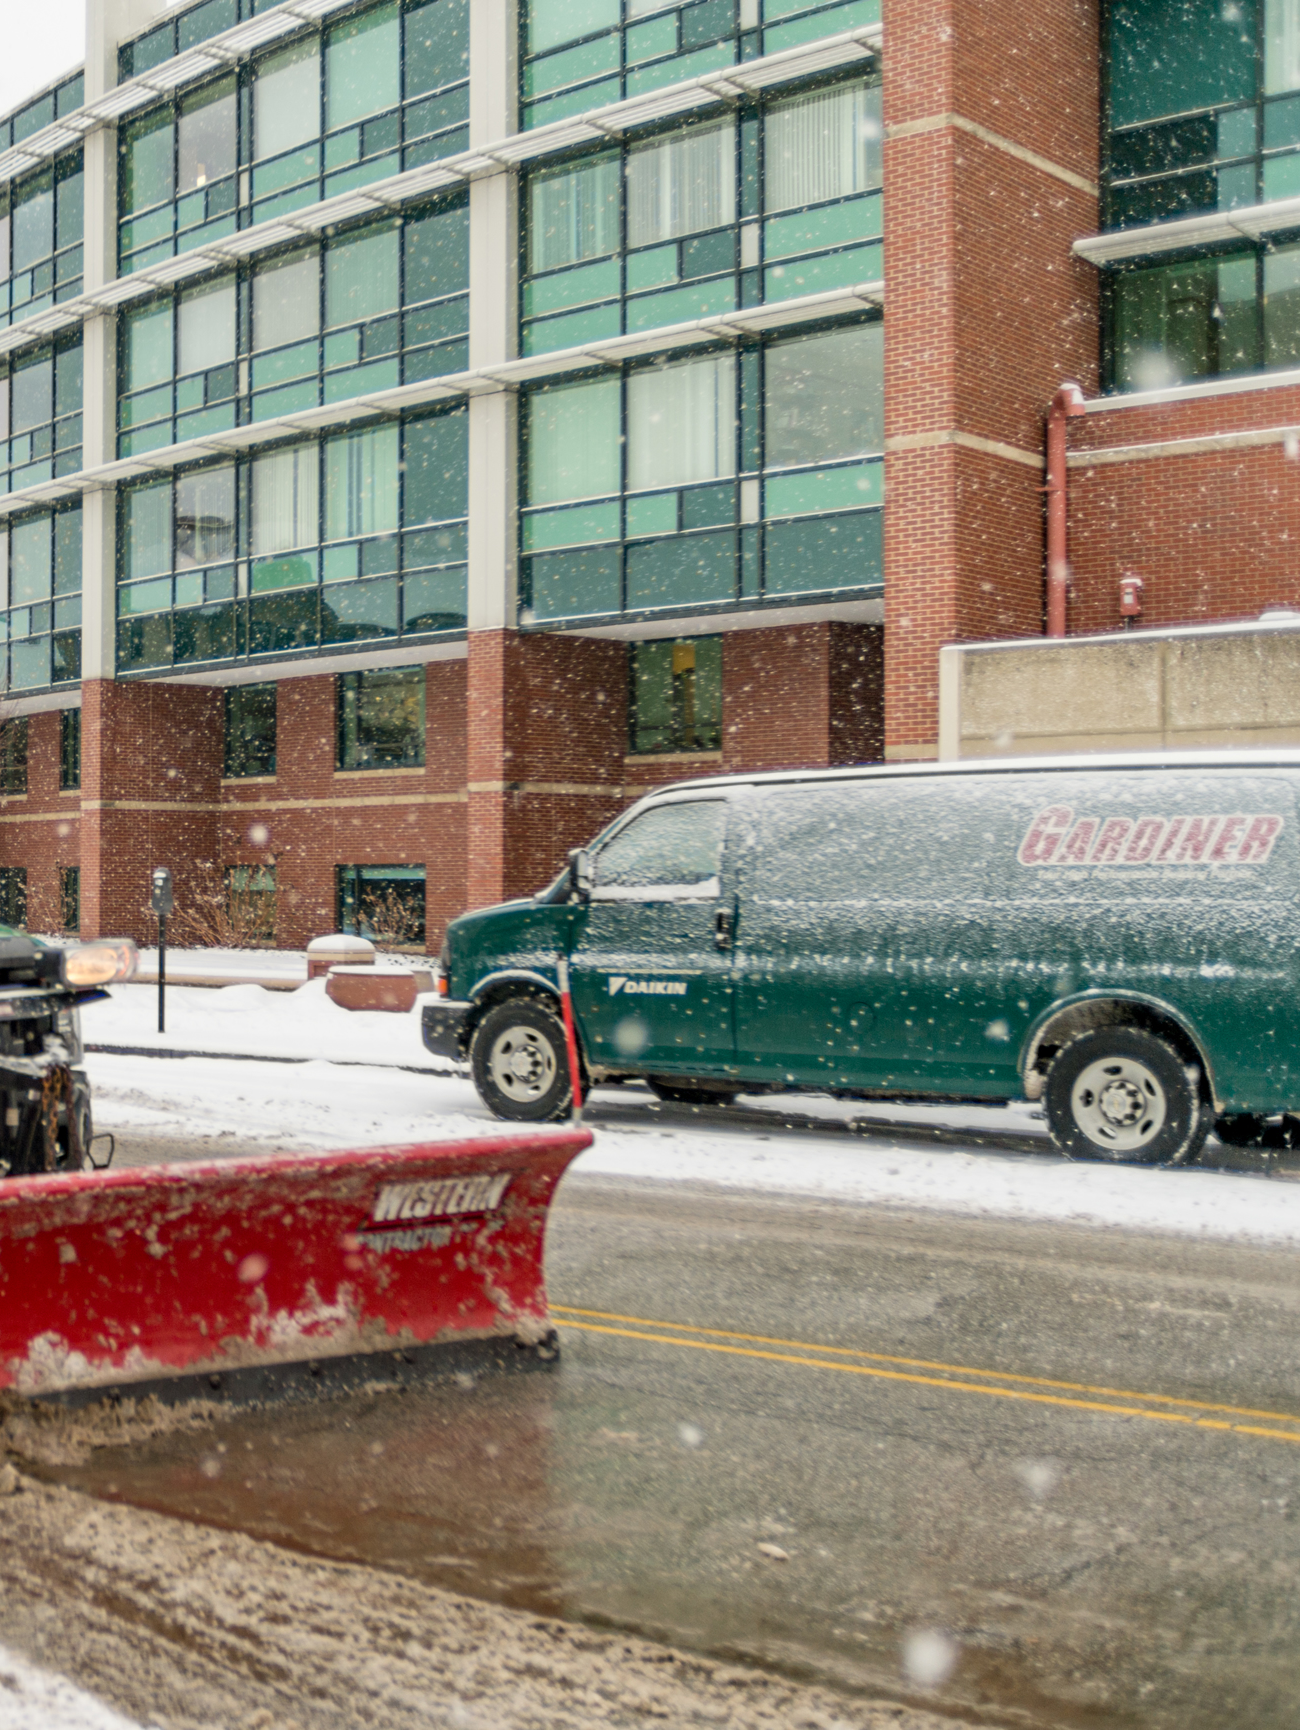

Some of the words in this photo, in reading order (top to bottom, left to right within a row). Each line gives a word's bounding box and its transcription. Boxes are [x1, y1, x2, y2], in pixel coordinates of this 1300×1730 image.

[1018, 805, 1284, 866] GARDINER
[623, 981, 688, 995] DAIKIN
[373, 1173, 511, 1222] WESTERN
